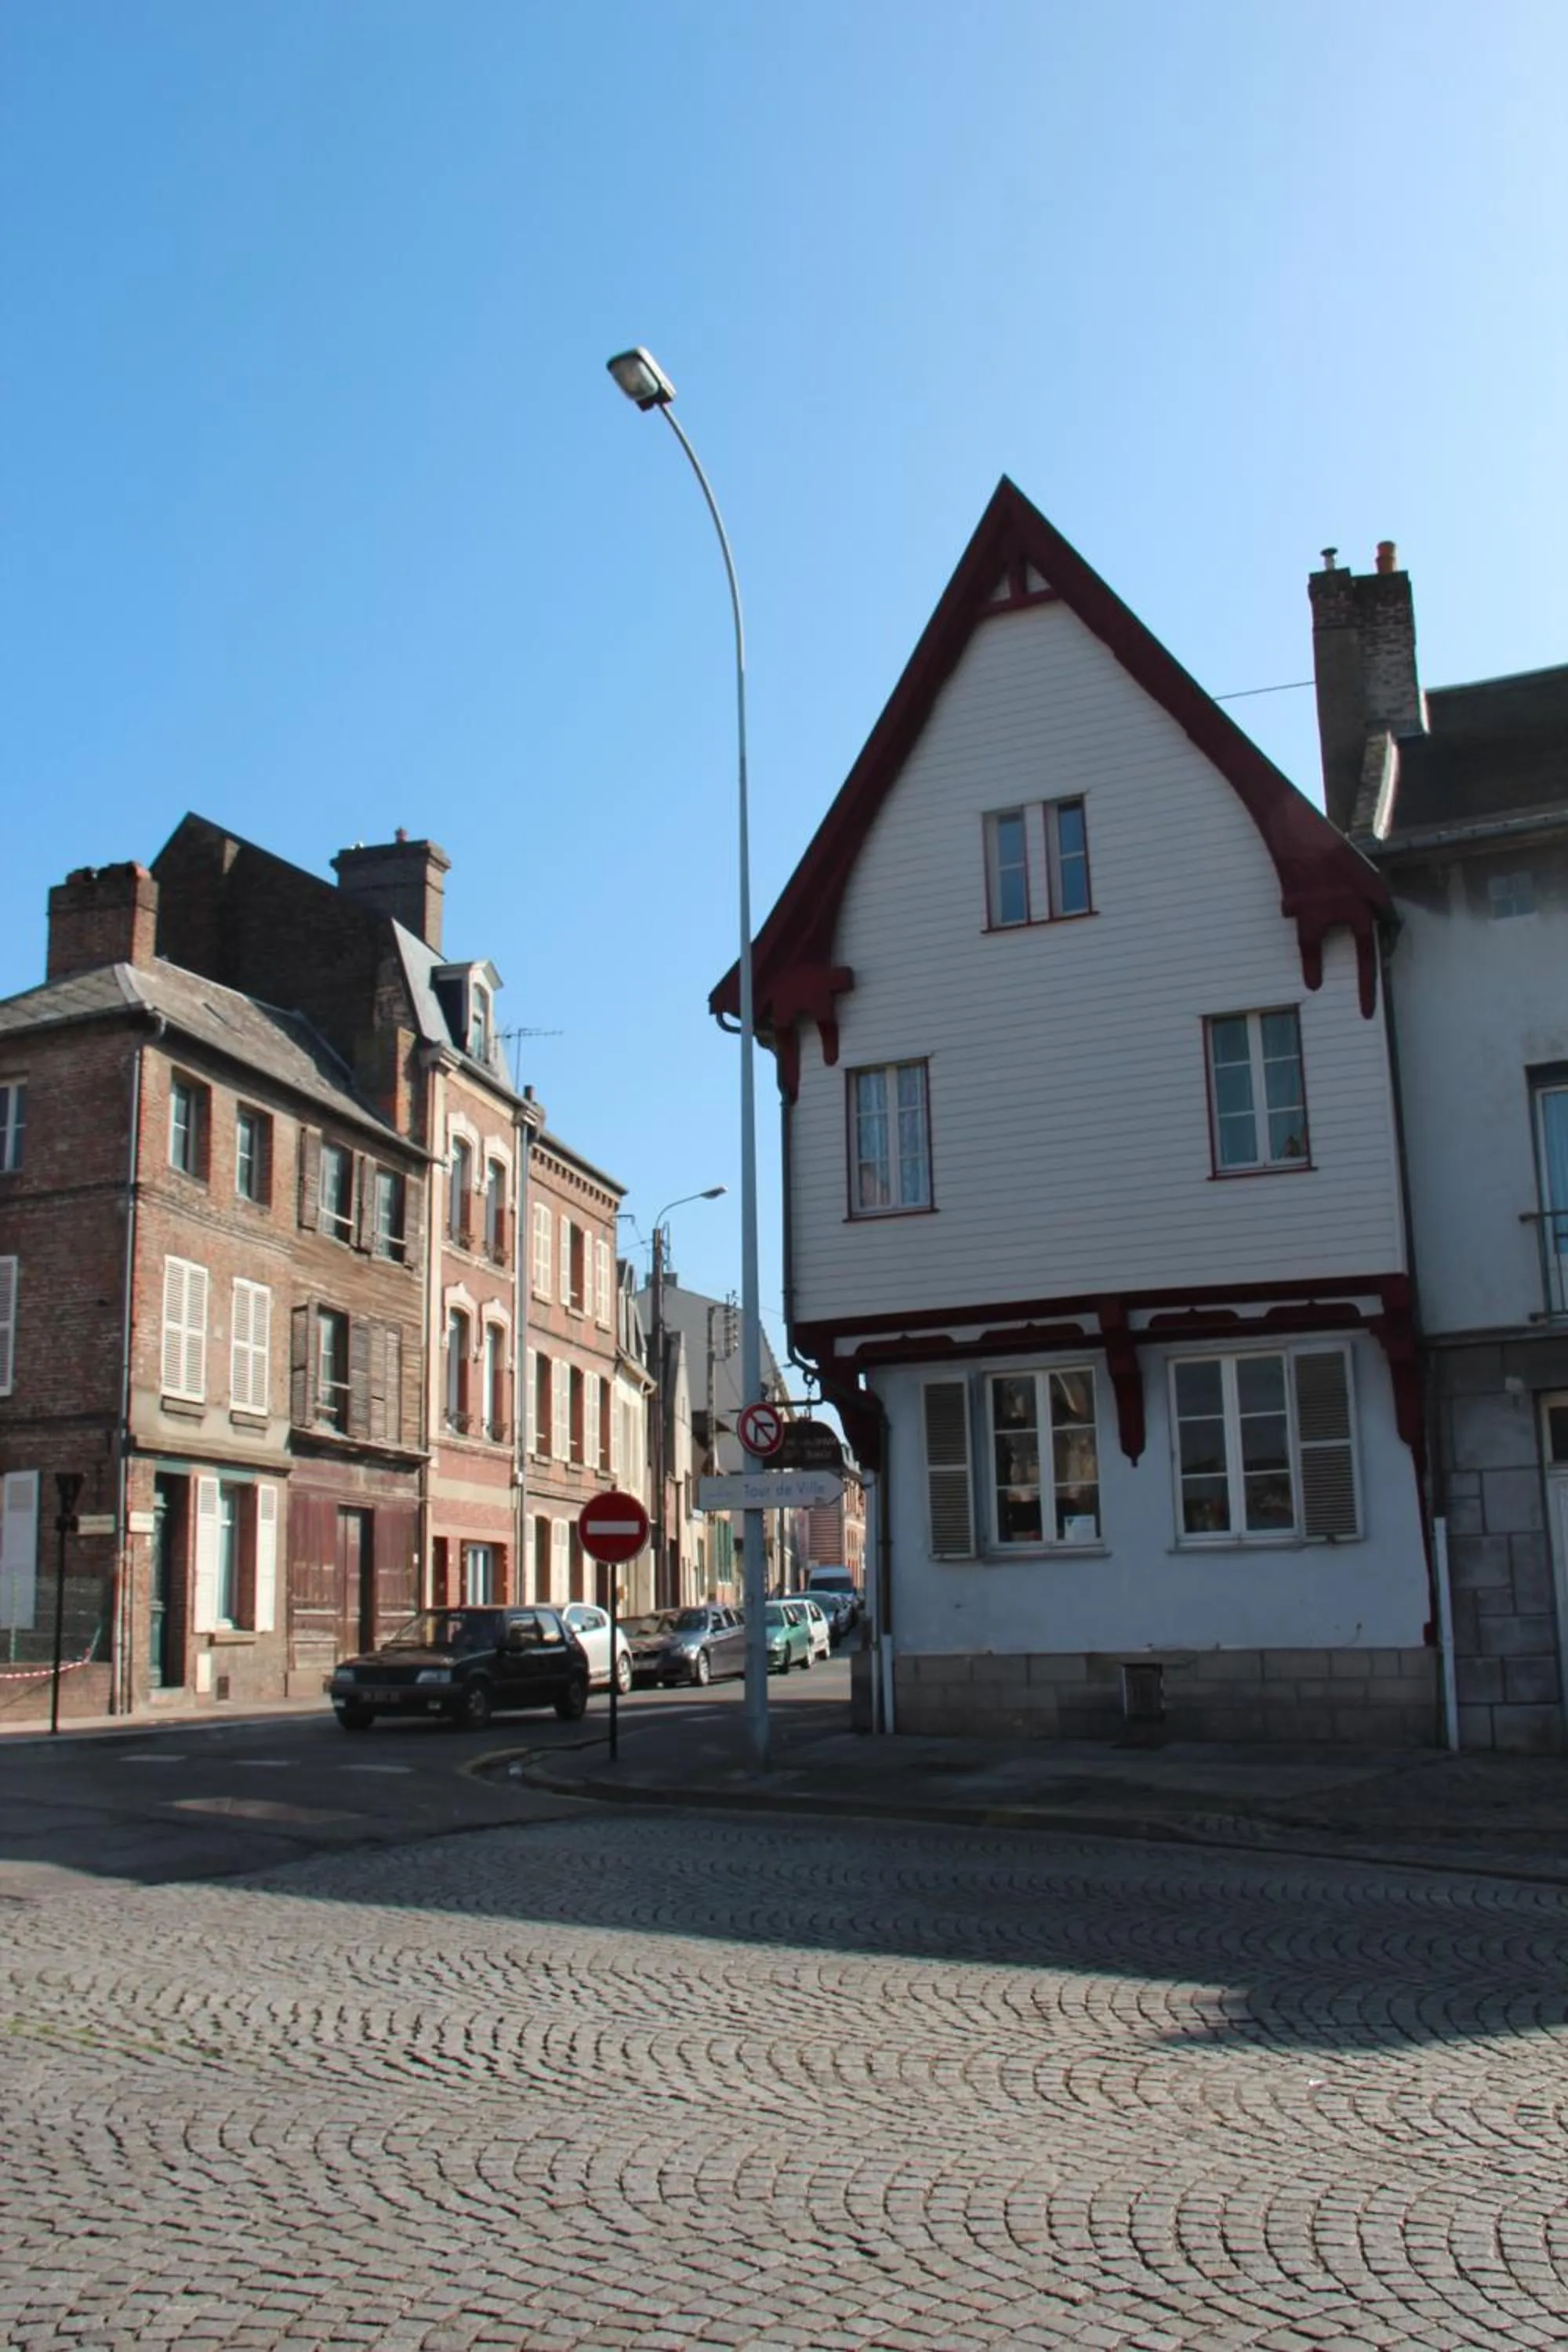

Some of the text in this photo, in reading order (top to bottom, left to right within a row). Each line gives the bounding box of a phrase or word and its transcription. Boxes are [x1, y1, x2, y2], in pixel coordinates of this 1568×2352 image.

[743, 1483, 770, 1497] Tour
[776, 1481, 793, 1497] de
[797, 1479, 826, 1494] Ville
